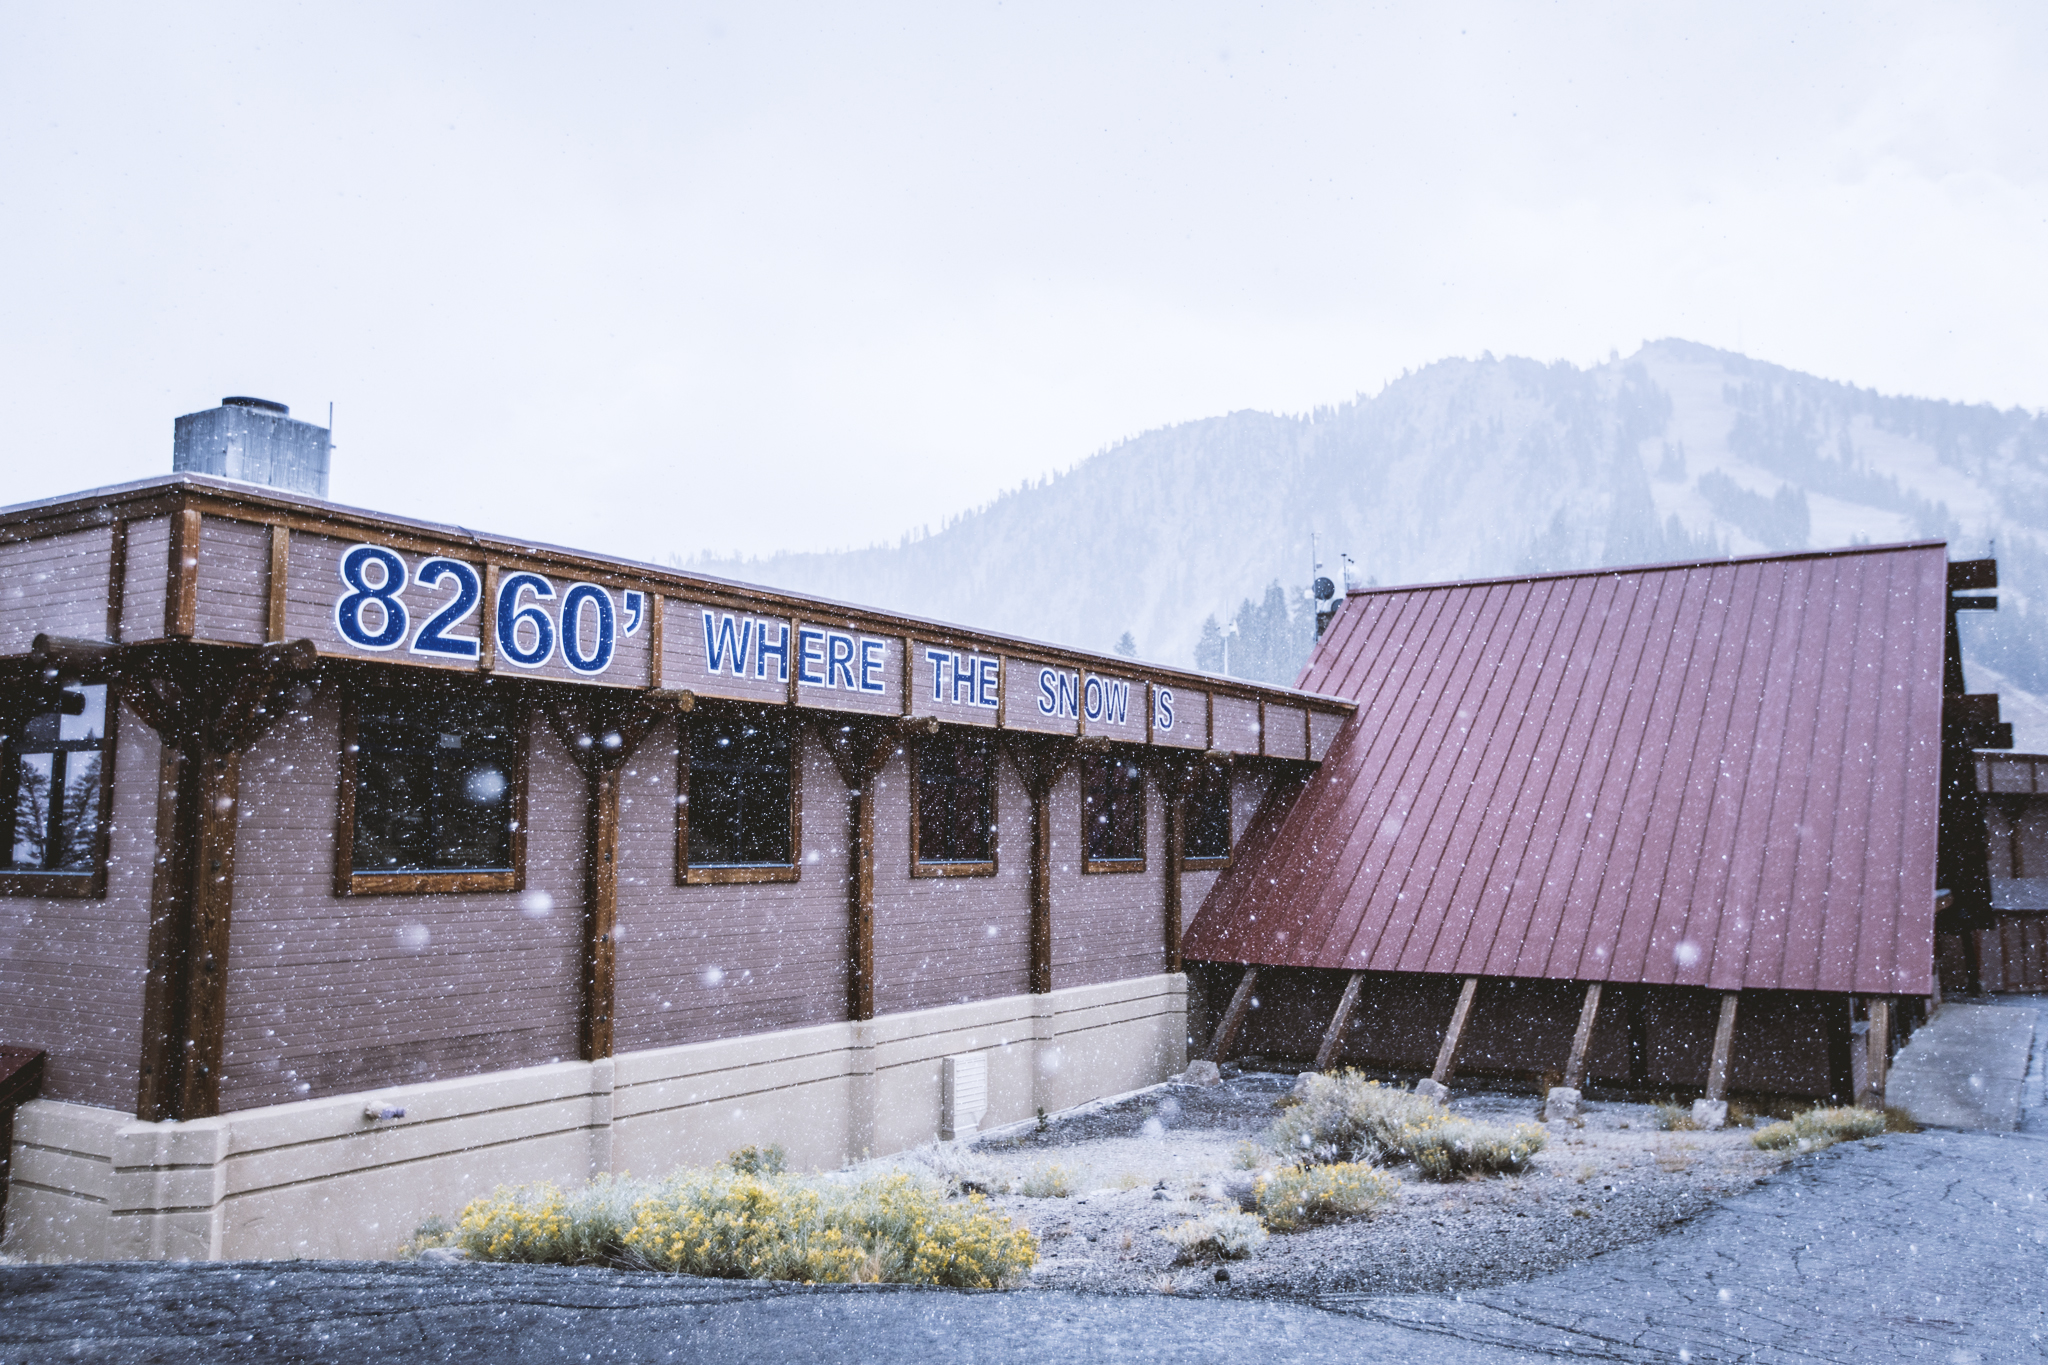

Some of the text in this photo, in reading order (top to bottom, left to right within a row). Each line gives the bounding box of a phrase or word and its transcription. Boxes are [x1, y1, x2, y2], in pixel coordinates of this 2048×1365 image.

[702, 610, 886, 694] WHERE
[926, 648, 999, 709] THE
[1037, 667, 1130, 725] SNOW
